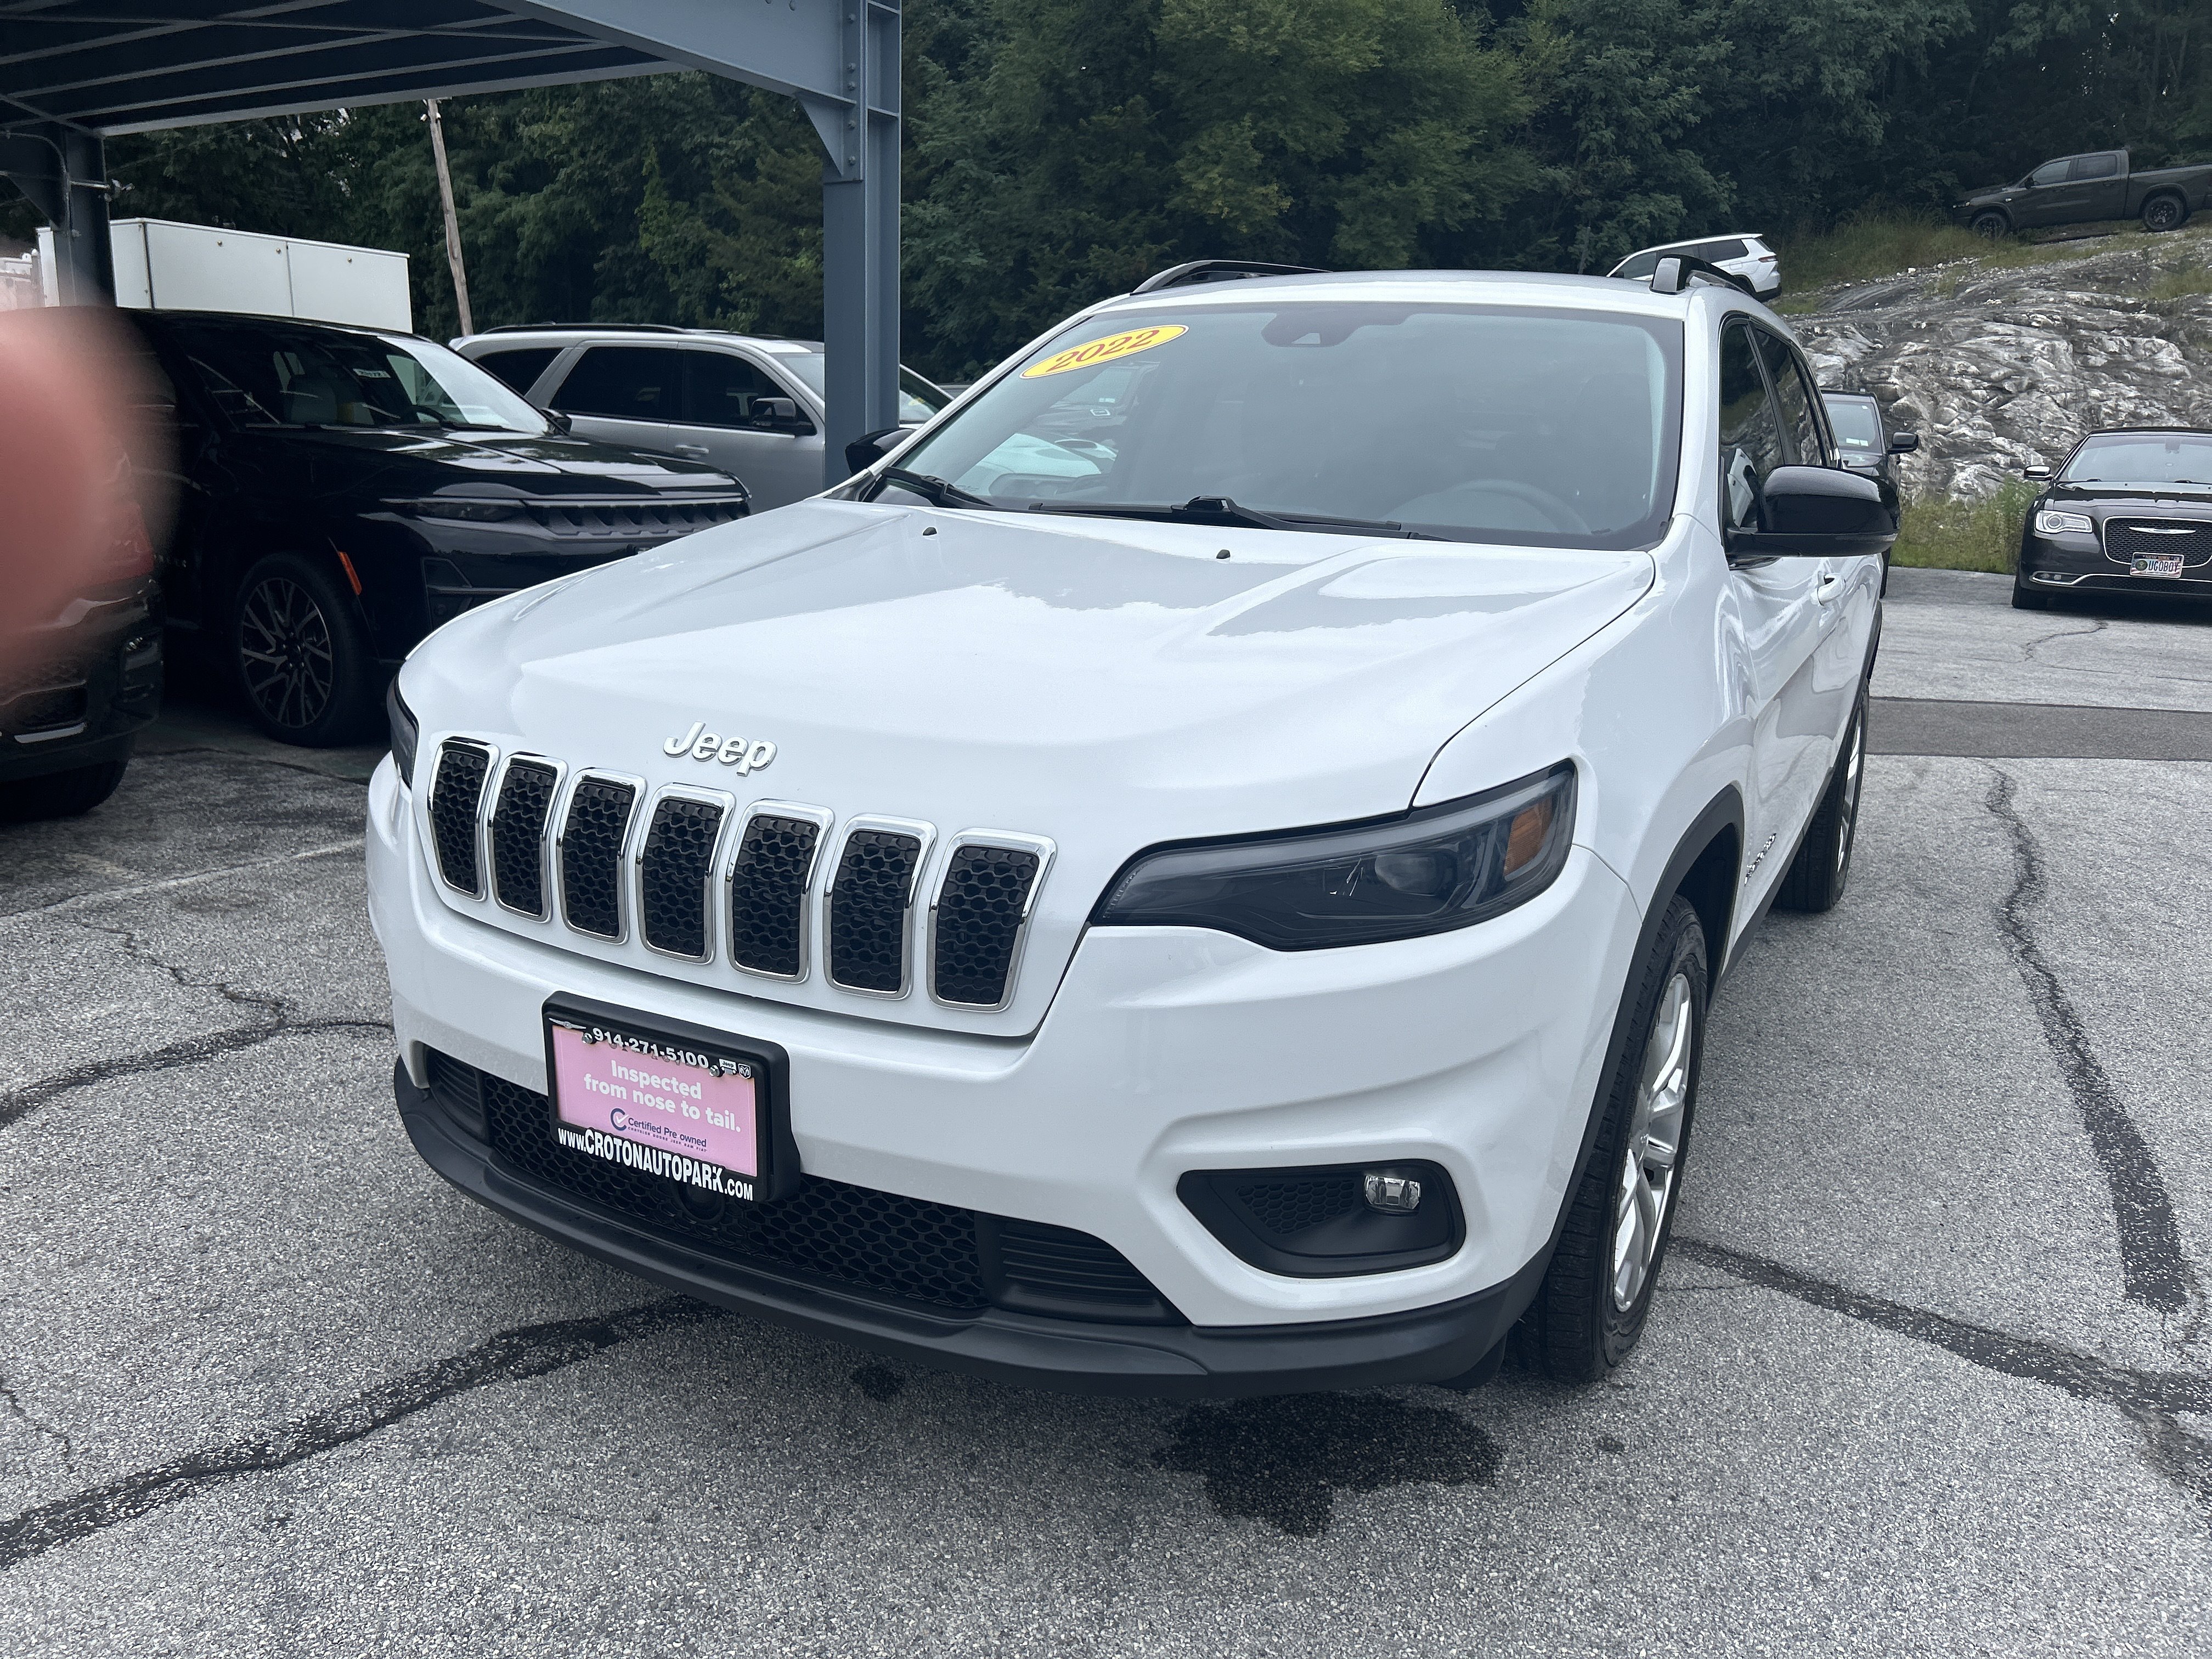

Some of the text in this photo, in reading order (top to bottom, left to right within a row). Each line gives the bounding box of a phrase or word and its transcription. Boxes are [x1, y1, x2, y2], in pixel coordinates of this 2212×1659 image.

[1045, 329, 1160, 373] 2022
[663, 721, 777, 777] Jeep
[592, 1028, 709, 1069] 914-271-5100
[611, 1059, 702, 1099] Inspected
[583, 1073, 742, 1133] from nose to tail.
[628, 1117, 707, 1148] Certified Pre owned
